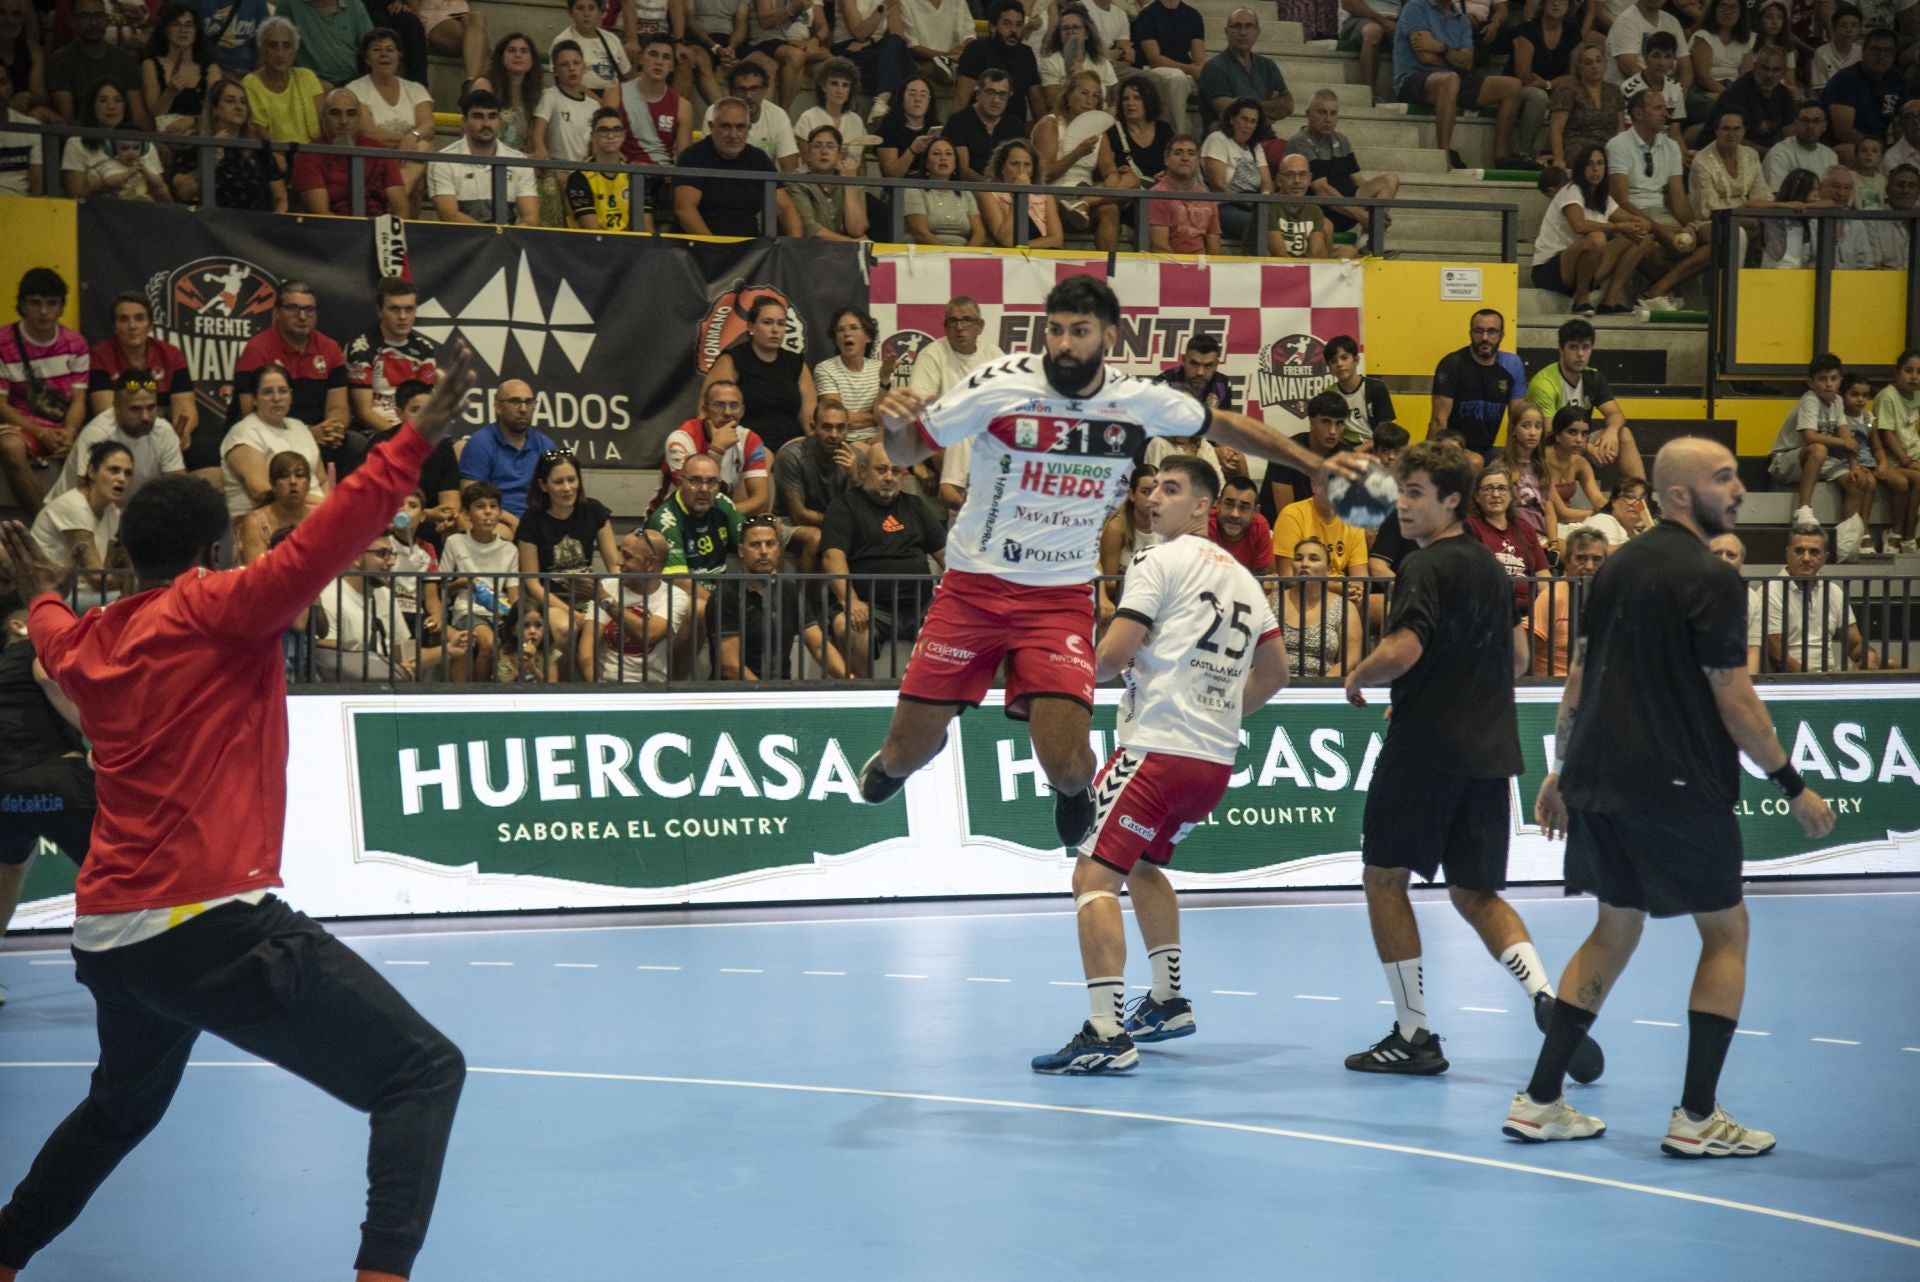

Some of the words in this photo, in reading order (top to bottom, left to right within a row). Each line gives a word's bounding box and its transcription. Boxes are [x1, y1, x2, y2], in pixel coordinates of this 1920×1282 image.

[195, 316, 251, 337] FRENTE
[1282, 365, 1314, 376] FRENTE
[1047, 462, 1112, 480] VIVEROS
[1196, 591, 1253, 660] 25
[399, 731, 868, 816] HUERCASA
[1227, 806, 1337, 826] COUNTRY
[497, 820, 620, 843] SABOREA
[628, 820, 656, 838] EL
[664, 816, 789, 839] COUNTRY
